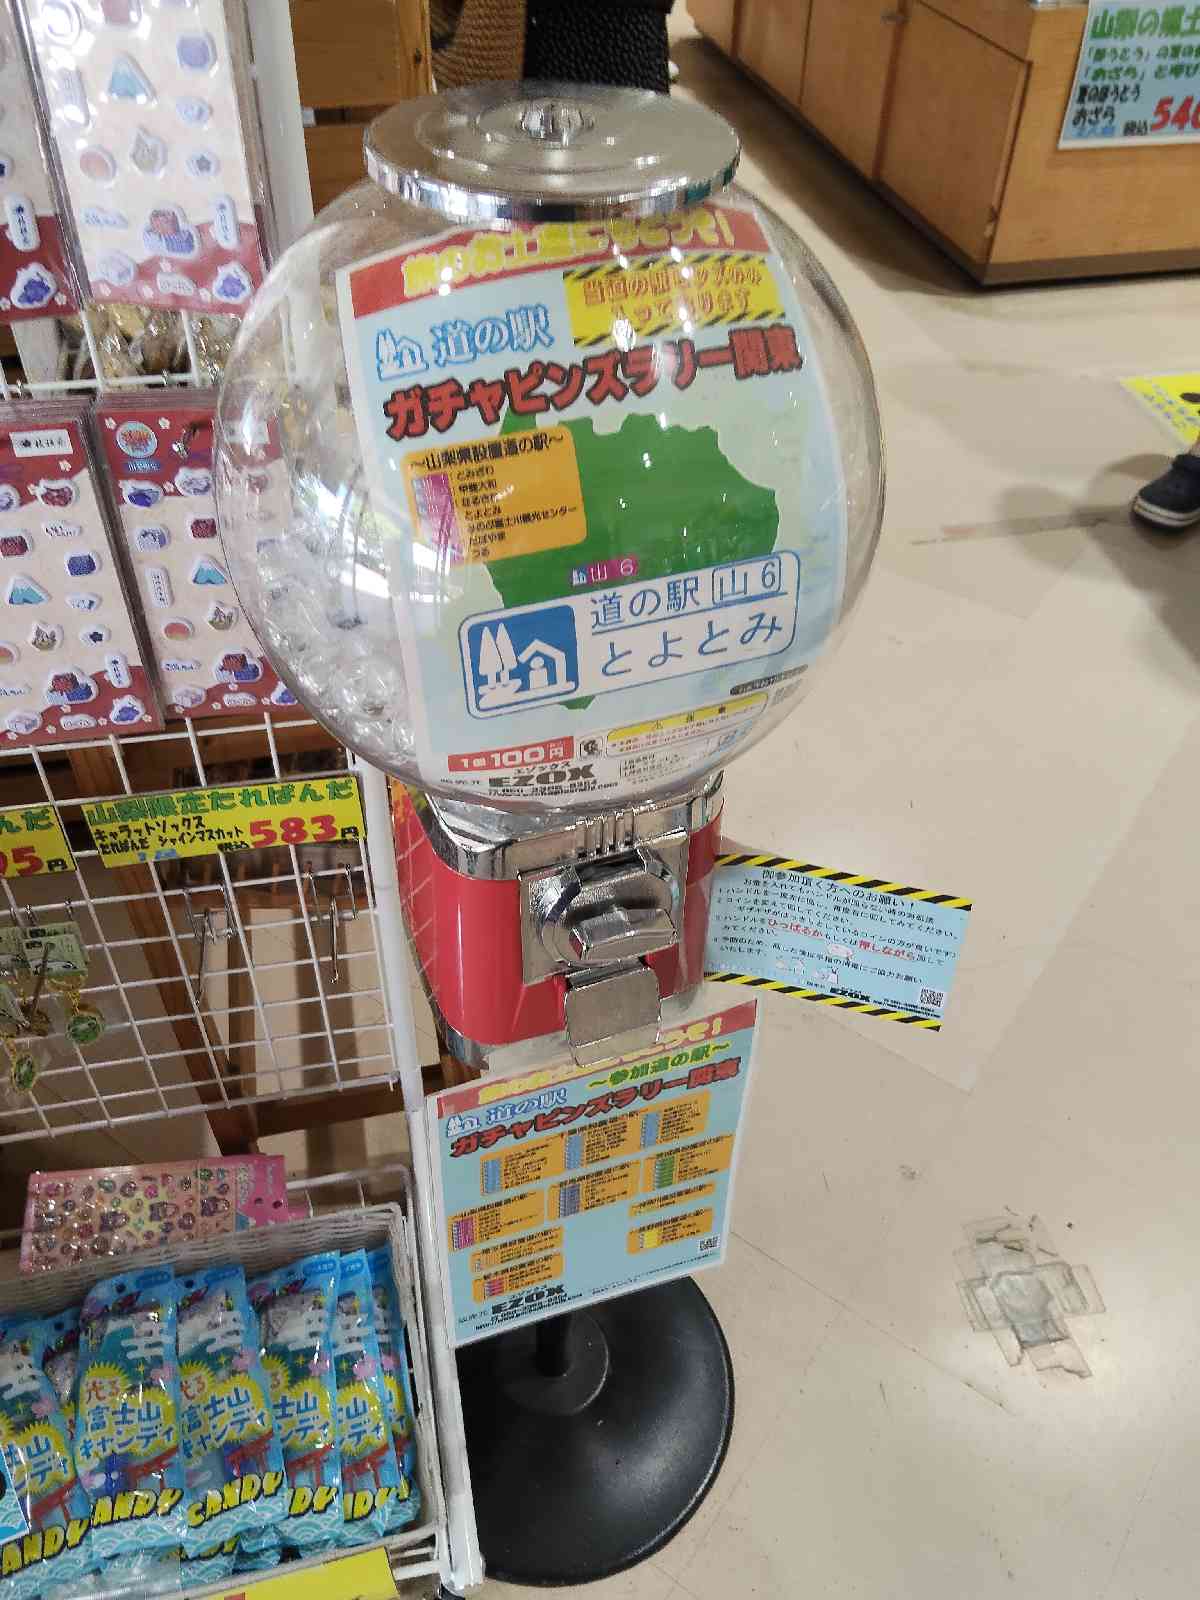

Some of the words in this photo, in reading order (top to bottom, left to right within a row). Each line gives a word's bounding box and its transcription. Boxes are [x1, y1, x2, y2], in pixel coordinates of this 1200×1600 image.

[431, 304, 555, 366] 道の駅
[591, 576, 700, 629] 道の駅
[602, 611, 783, 676] とよとみ
[489, 763, 595, 788] EZOX
[88, 1402, 161, 1431] 富士山
[183, 1387, 250, 1432] 富士山
[272, 1391, 318, 1419] 士山
[80, 1423, 174, 1459] キャンディ
[187, 1471, 284, 1528] CANDY
[0, 1519, 89, 1577] ANDY
